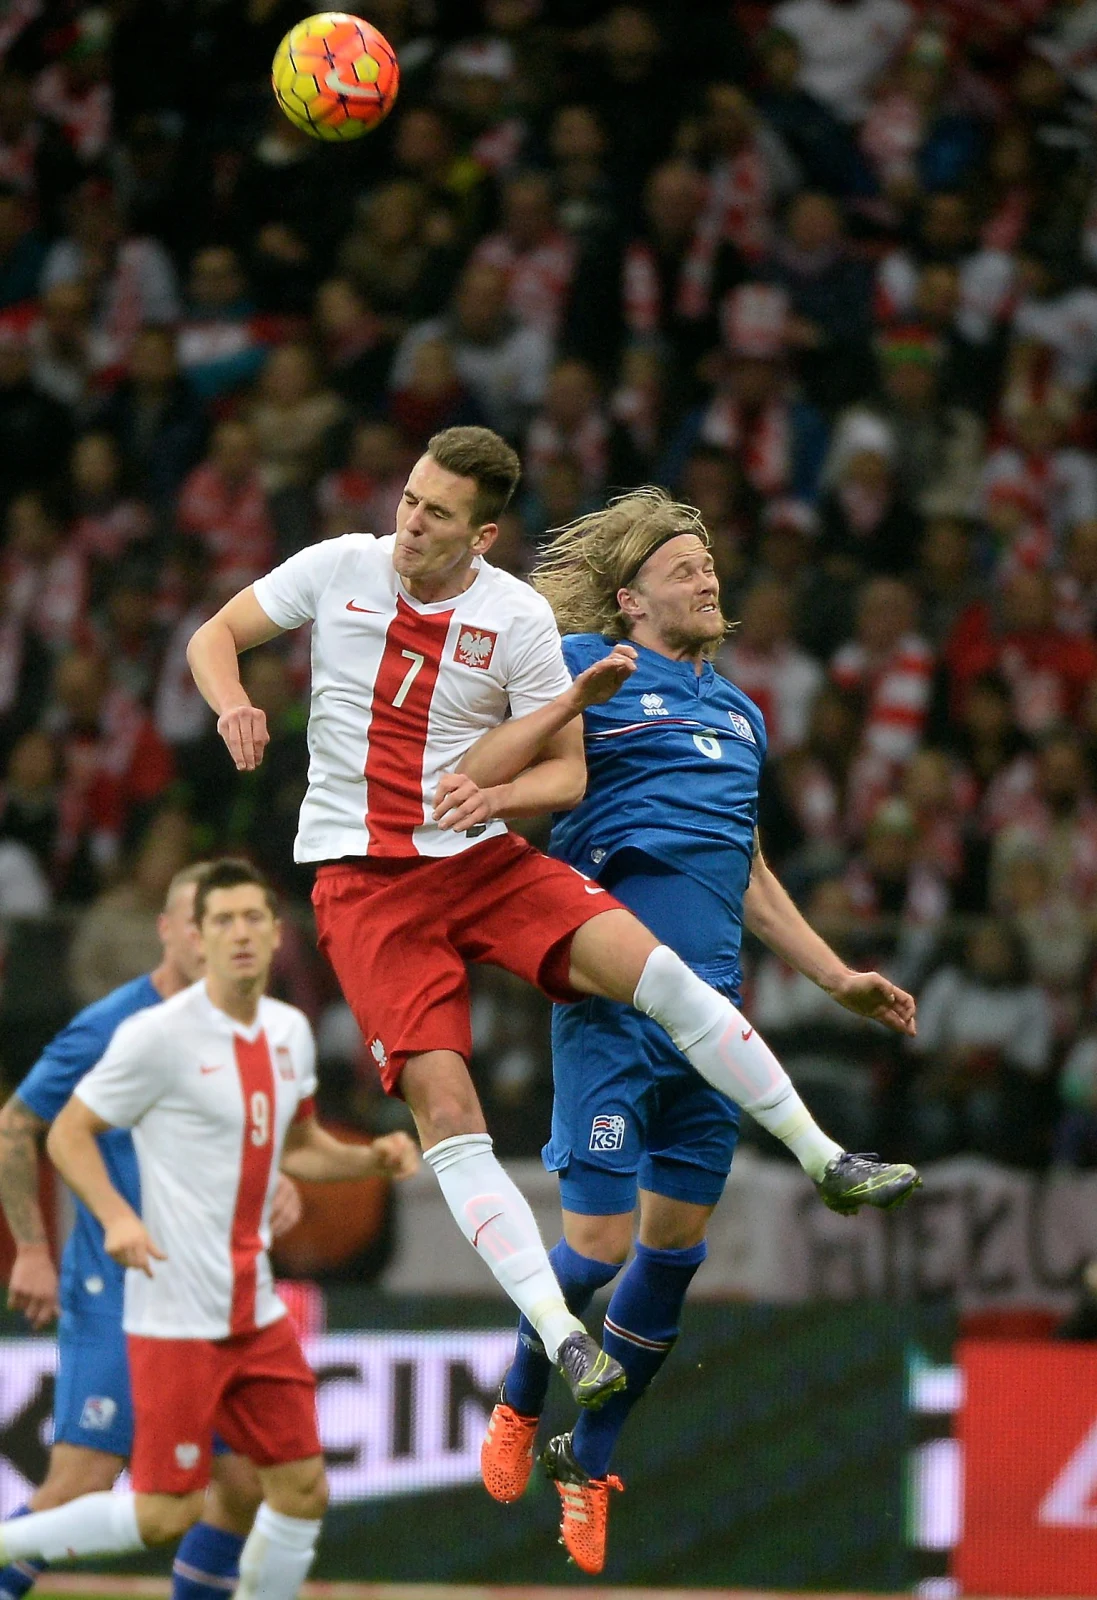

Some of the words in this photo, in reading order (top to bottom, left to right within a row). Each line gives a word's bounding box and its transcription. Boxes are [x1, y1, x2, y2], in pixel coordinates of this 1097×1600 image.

[391, 649, 425, 708] 7
[692, 728, 722, 760] 6
[251, 1091, 269, 1147] 9
